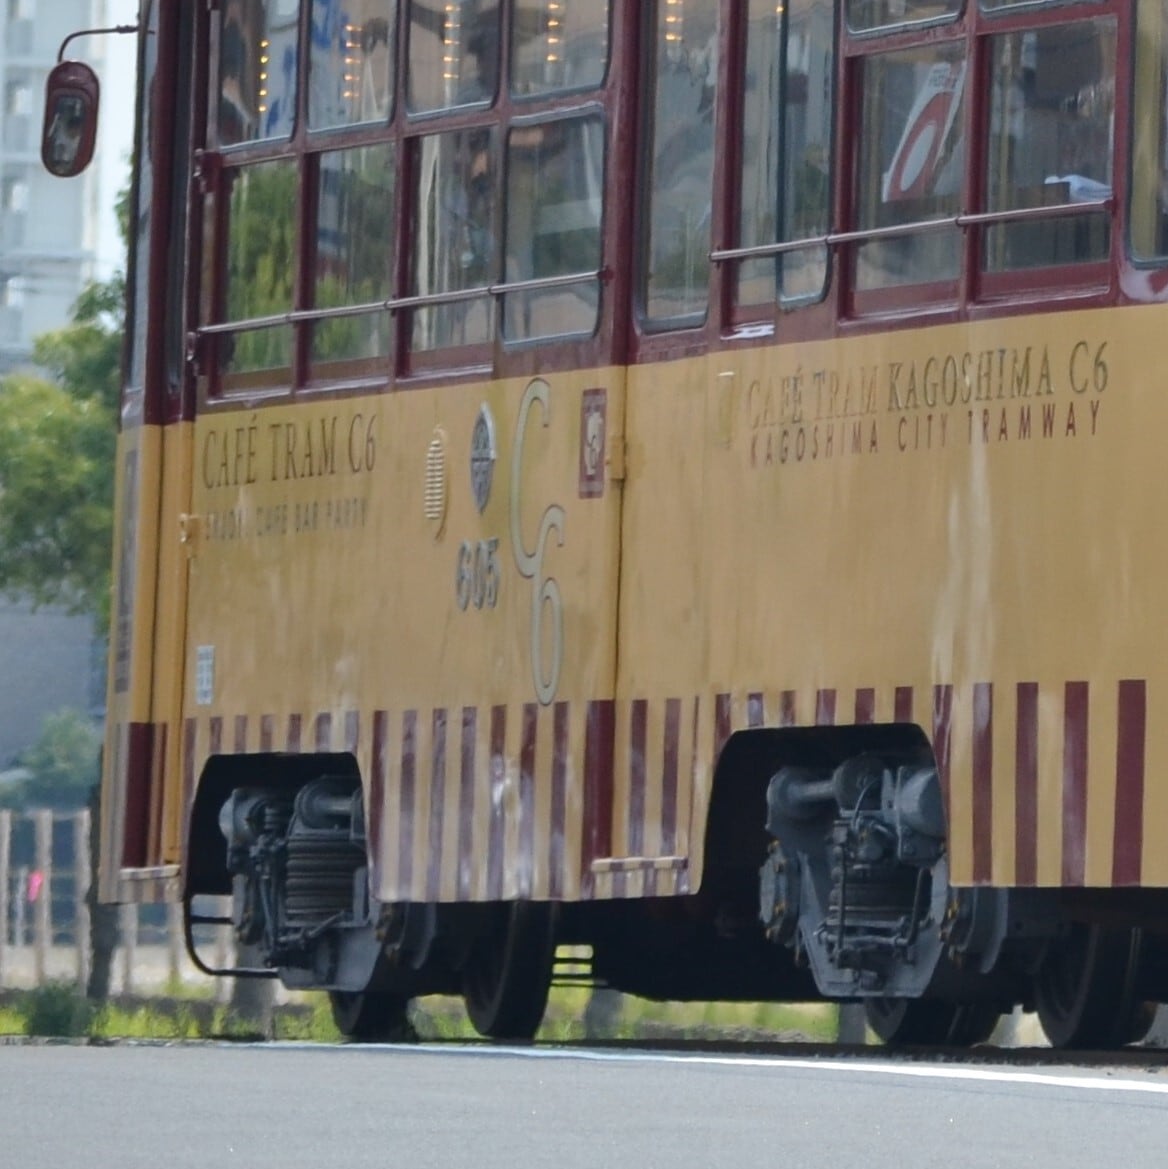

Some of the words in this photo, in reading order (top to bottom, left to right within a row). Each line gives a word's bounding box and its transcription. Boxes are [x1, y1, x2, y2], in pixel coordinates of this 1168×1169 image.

[813, 365, 878, 420] TRAM
[887, 345, 1055, 412] KAGOSHIMA
[1069, 340, 1109, 395] C6
[203, 414, 257, 489] CAFÉ
[269, 416, 338, 481] TRAM
[349, 413, 376, 473] C6
[751, 419, 879, 469] KAGOSHIMA
[897, 412, 949, 452] CITY
[967, 399, 1101, 444] TRAMWAY
[457, 537, 500, 612] 605
[511, 377, 566, 706] C6
